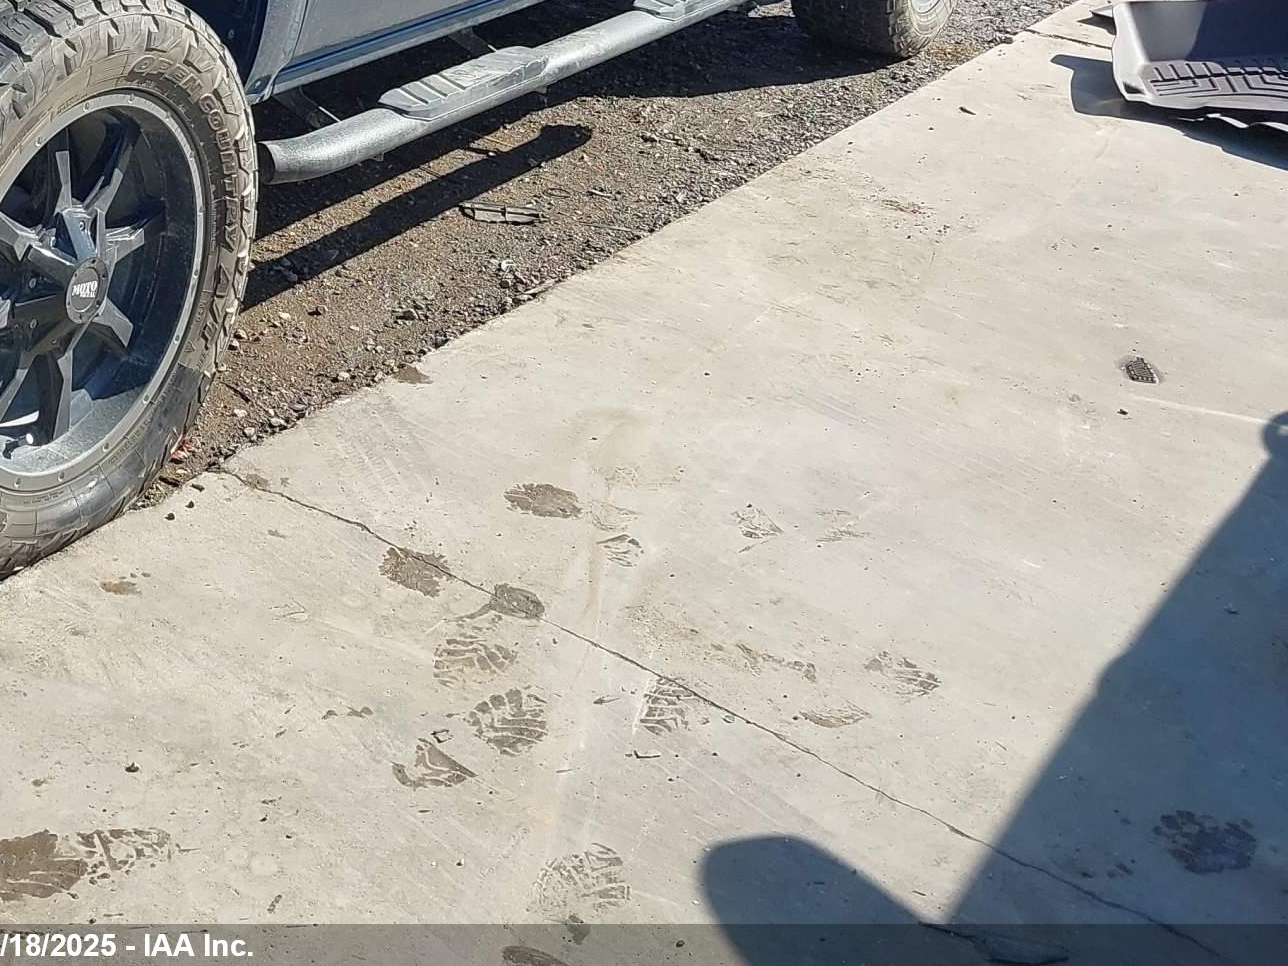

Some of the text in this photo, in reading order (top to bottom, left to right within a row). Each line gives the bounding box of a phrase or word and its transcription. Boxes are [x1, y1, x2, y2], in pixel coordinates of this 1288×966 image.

[133, 54, 204, 104] OPEN
[198, 93, 241, 252] COUNTRY
[71, 280, 98, 296] MOTO
